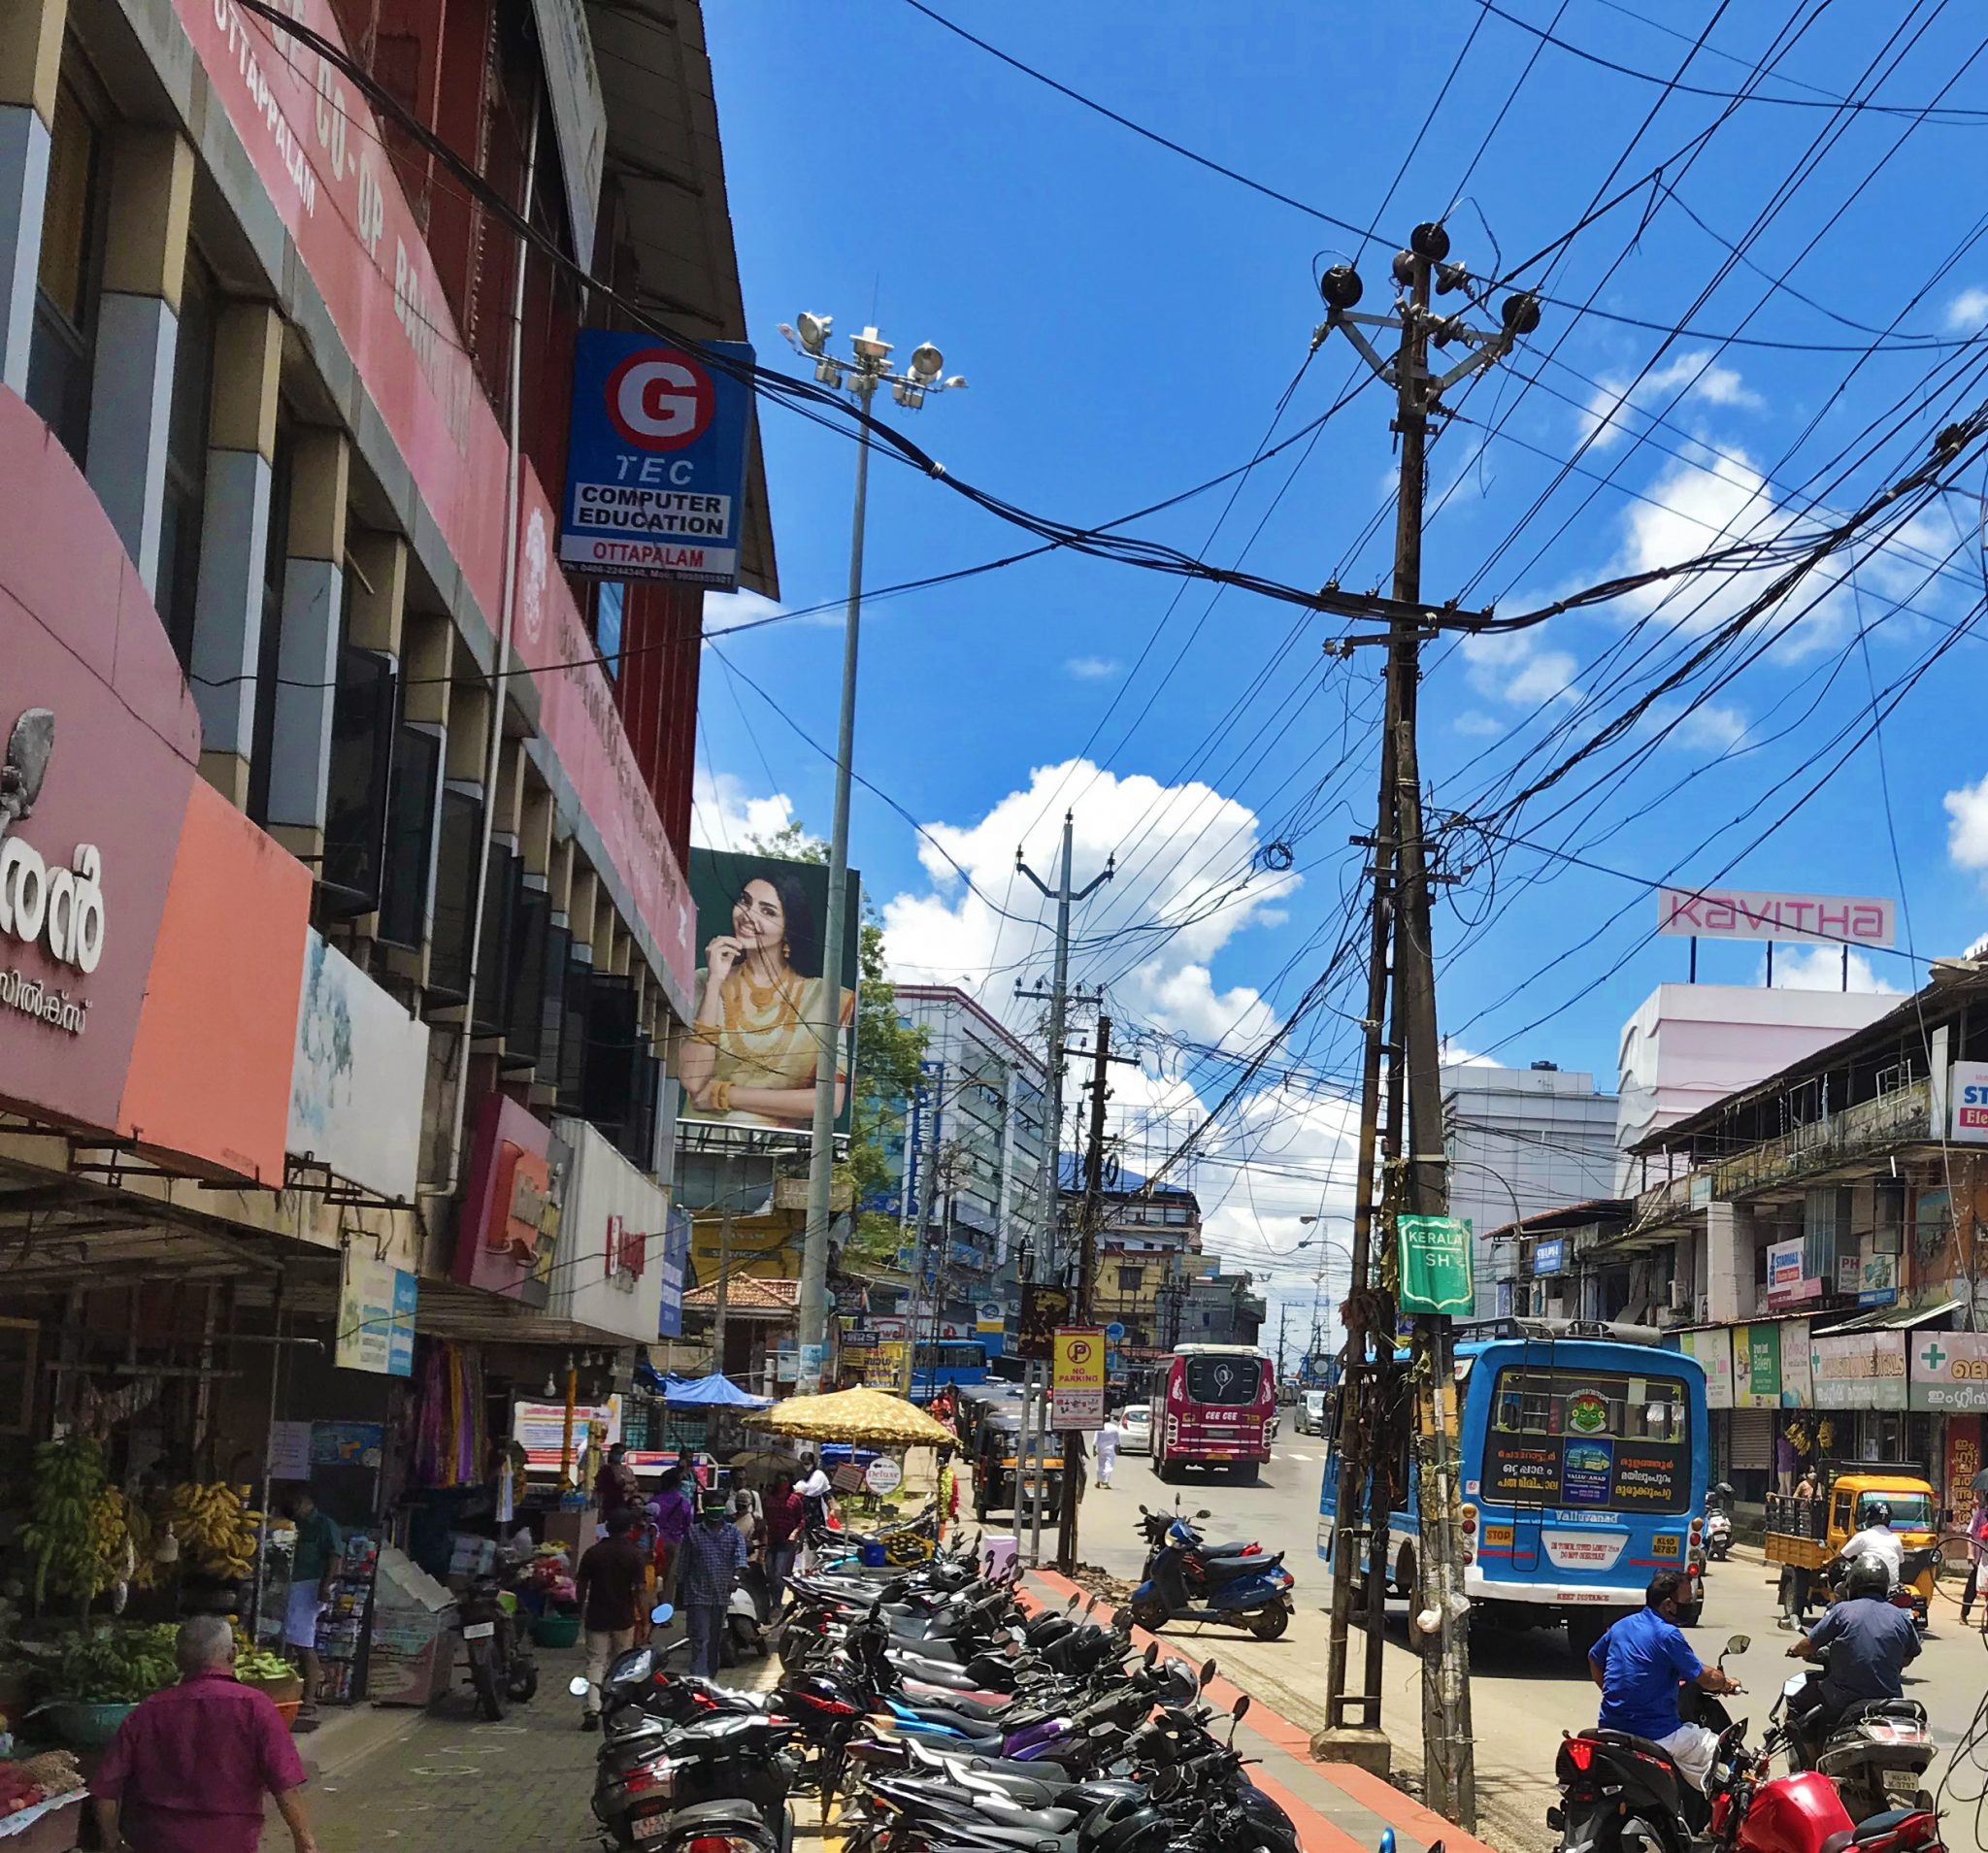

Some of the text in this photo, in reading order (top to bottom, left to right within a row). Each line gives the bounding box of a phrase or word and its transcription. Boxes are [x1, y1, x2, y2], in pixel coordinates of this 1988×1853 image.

[618, 361, 698, 437] G
[616, 455, 695, 485] TEC
[581, 485, 721, 514] COMPUTER
[578, 507, 724, 536] EDUCATION
[592, 542, 706, 569] OTTAPALAM
[1408, 1231, 1463, 1245] KERALA
[1425, 1253, 1450, 1268] SH
[1205, 1411, 1221, 1420] CEE
[1222, 1411, 1239, 1421] CEE
[1556, 1510, 1619, 1524] Valluvanad
[1486, 1530, 1511, 1540] STOP
